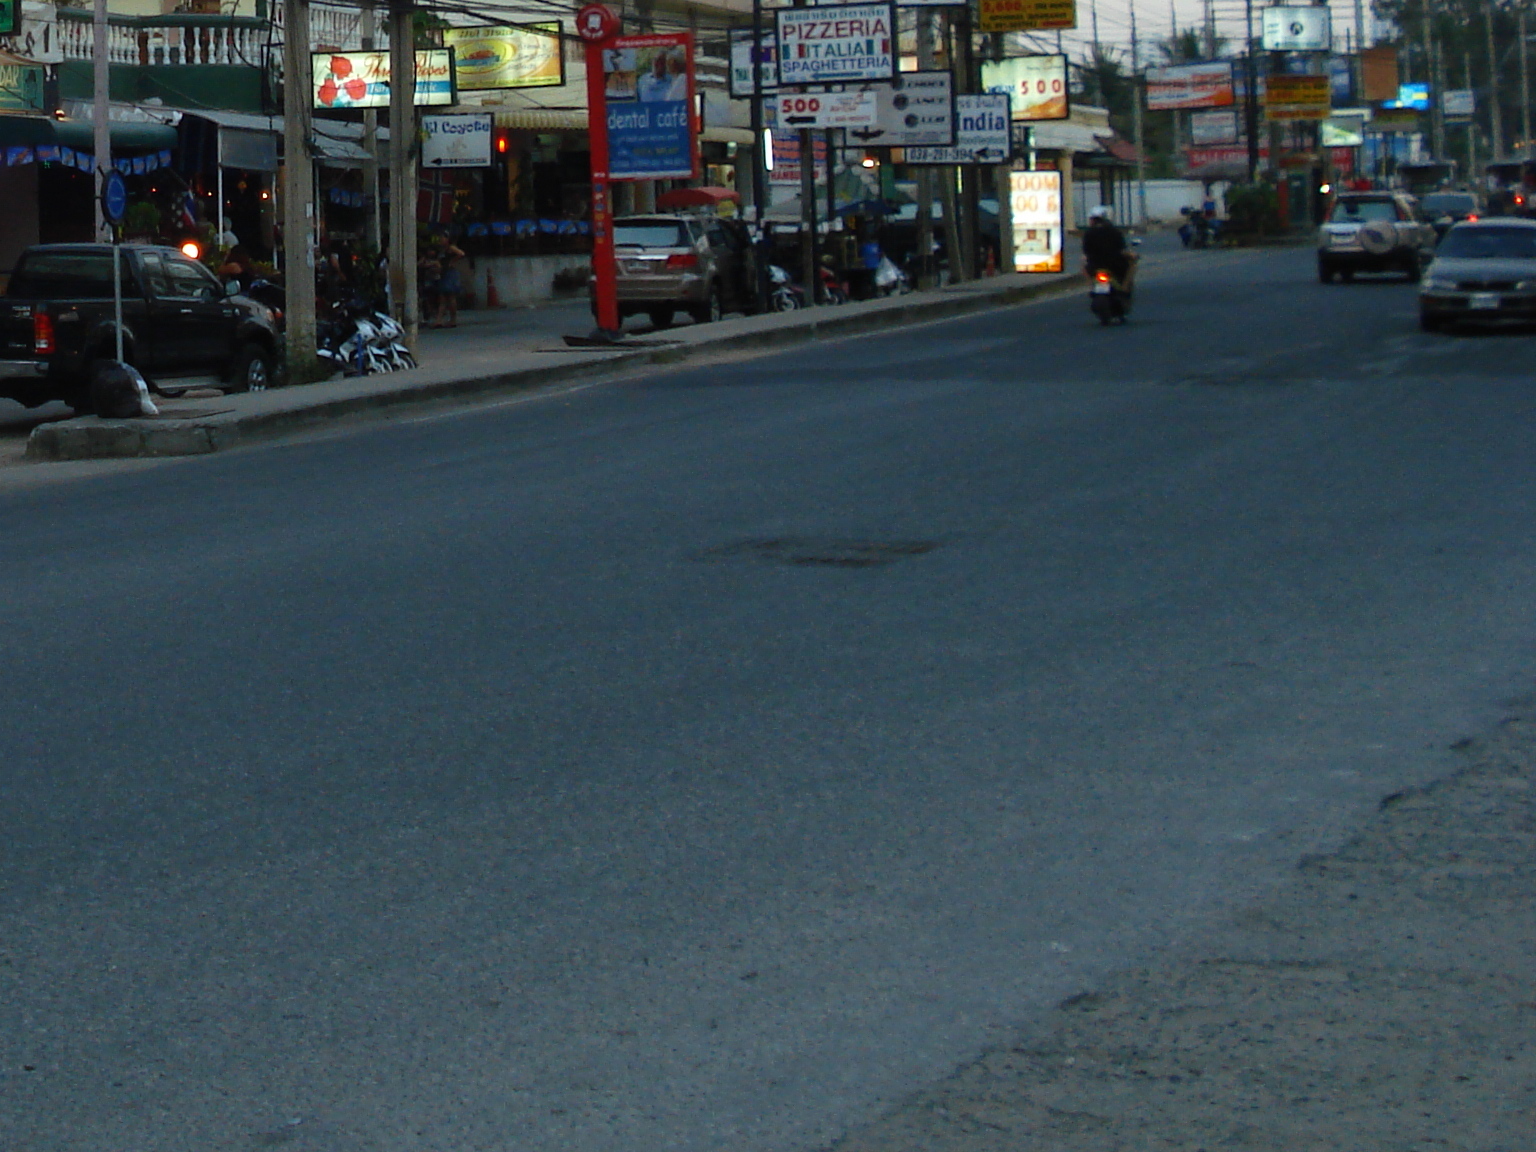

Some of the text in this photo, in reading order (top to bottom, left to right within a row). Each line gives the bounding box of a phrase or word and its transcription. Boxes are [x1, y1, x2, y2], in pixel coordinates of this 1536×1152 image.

[782, 19, 887, 40] PIZZERIA
[805, 42, 864, 58] ITALIA
[782, 57, 891, 73] SPAGHETTERIA
[1020, 78, 1062, 95] 500
[781, 98, 820, 113] 500
[607, 104, 687, 130] dental café
[442, 121, 490, 135] Coyote
